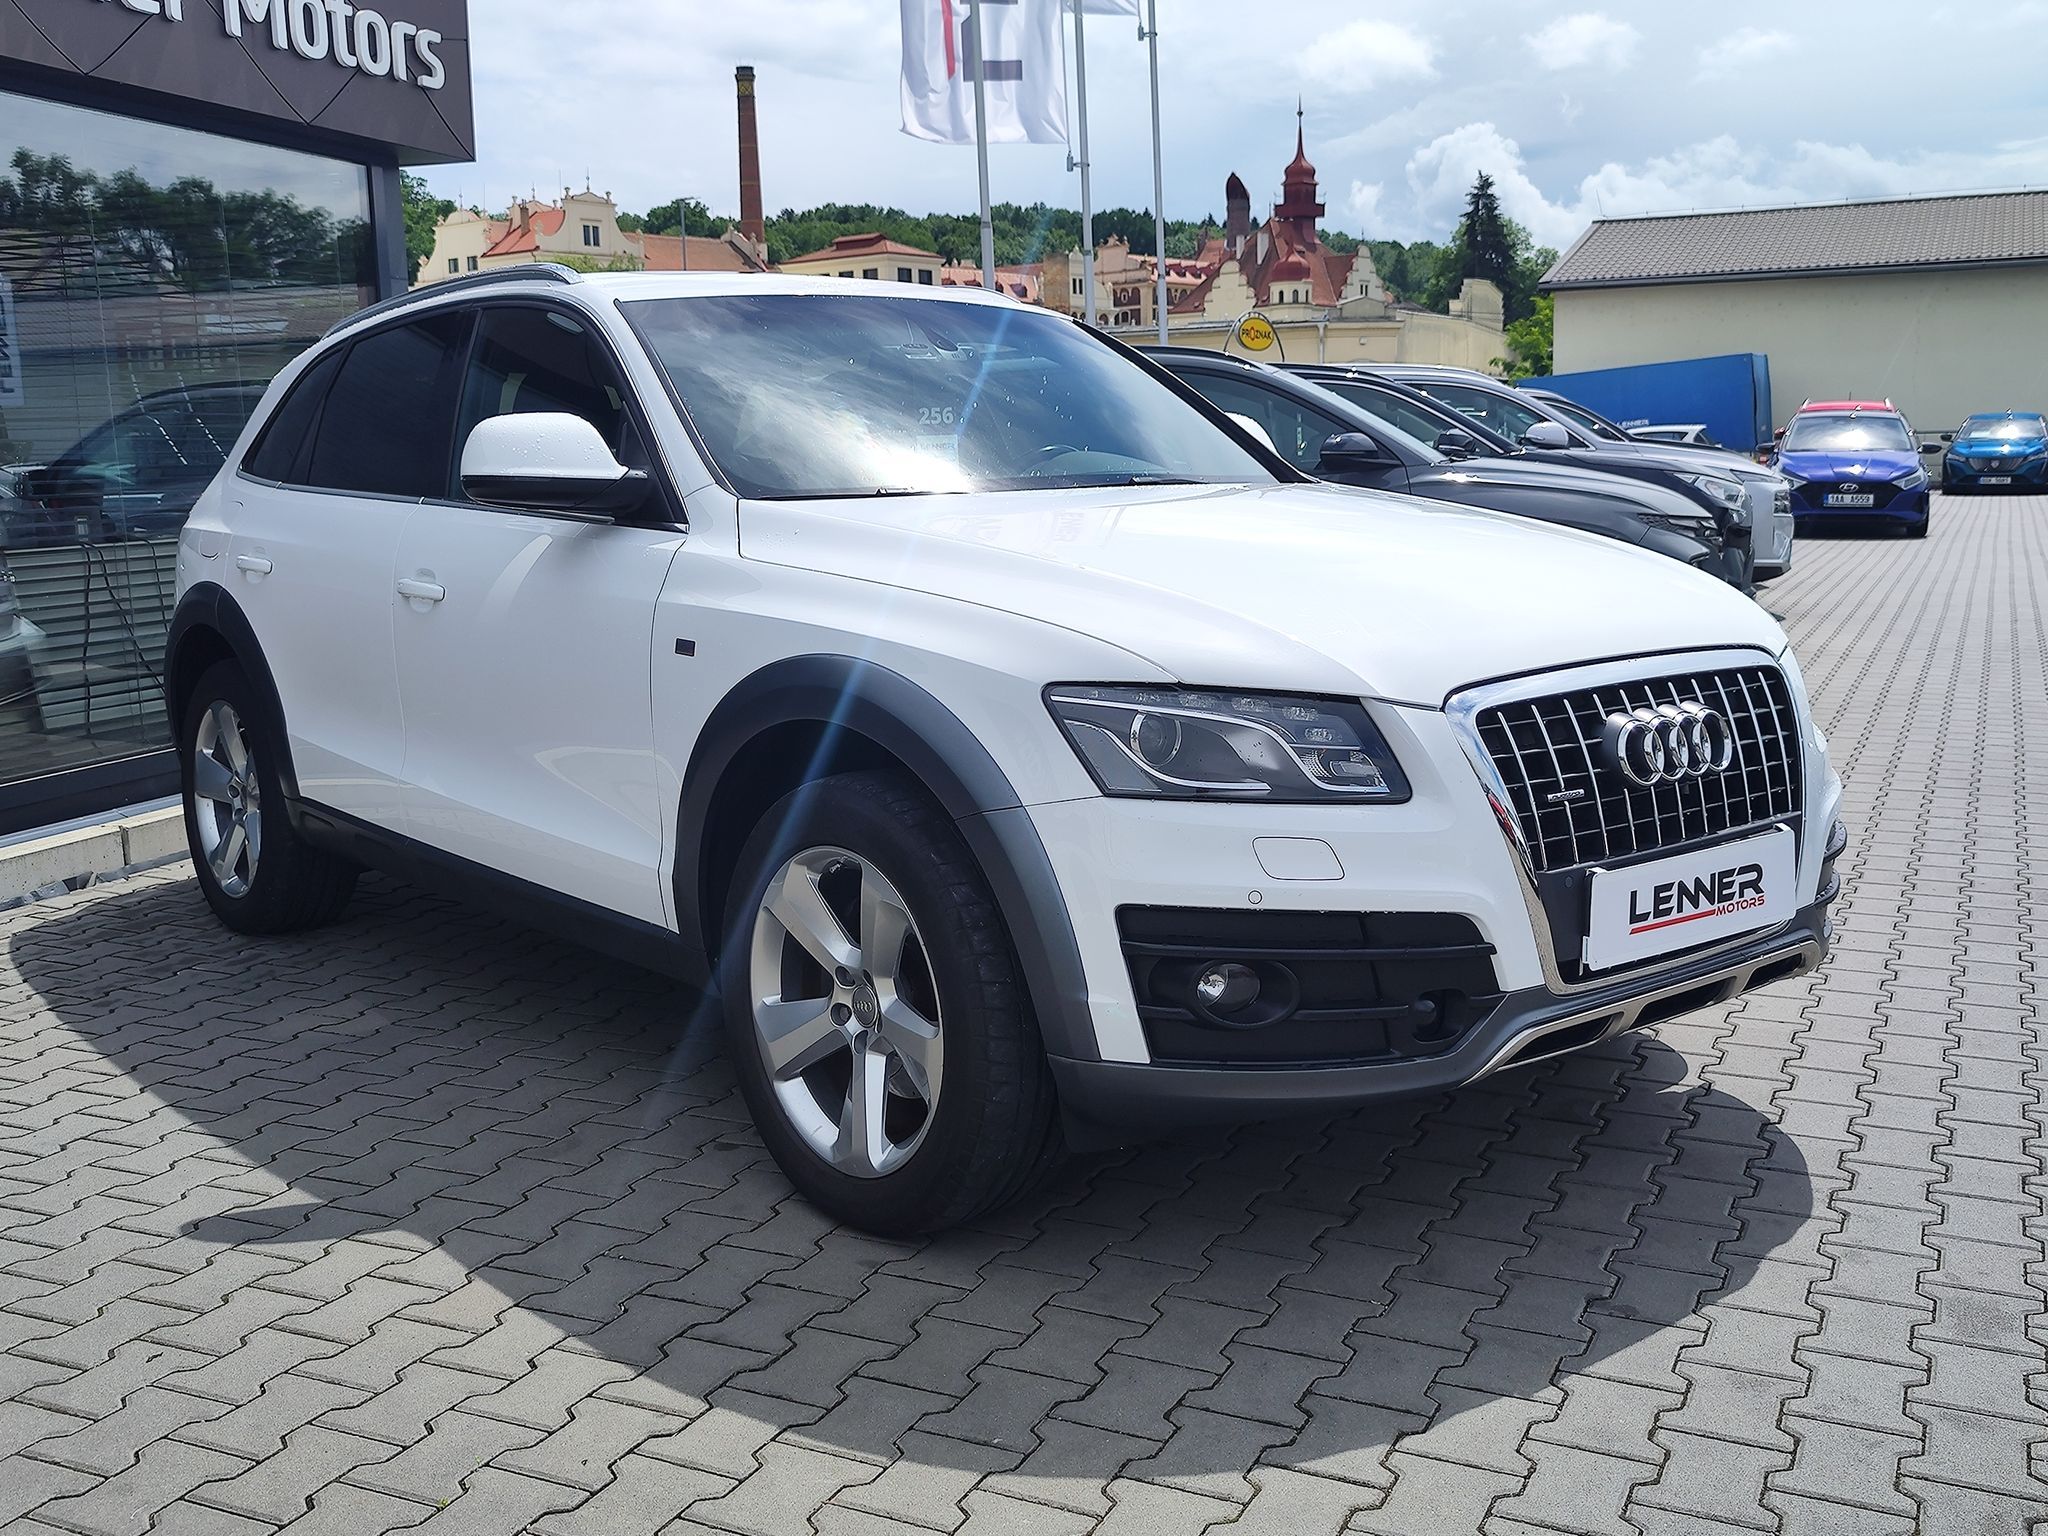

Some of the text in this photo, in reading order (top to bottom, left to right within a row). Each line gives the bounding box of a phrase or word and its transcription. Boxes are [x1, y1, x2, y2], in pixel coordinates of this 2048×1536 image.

[225, 0, 446, 89] Motors
[919, 406, 954, 425] 256
[1831, 495, 1845, 503] 1AA
[1629, 863, 1764, 924] LENNER
[1716, 895, 1765, 916] MOTORS
